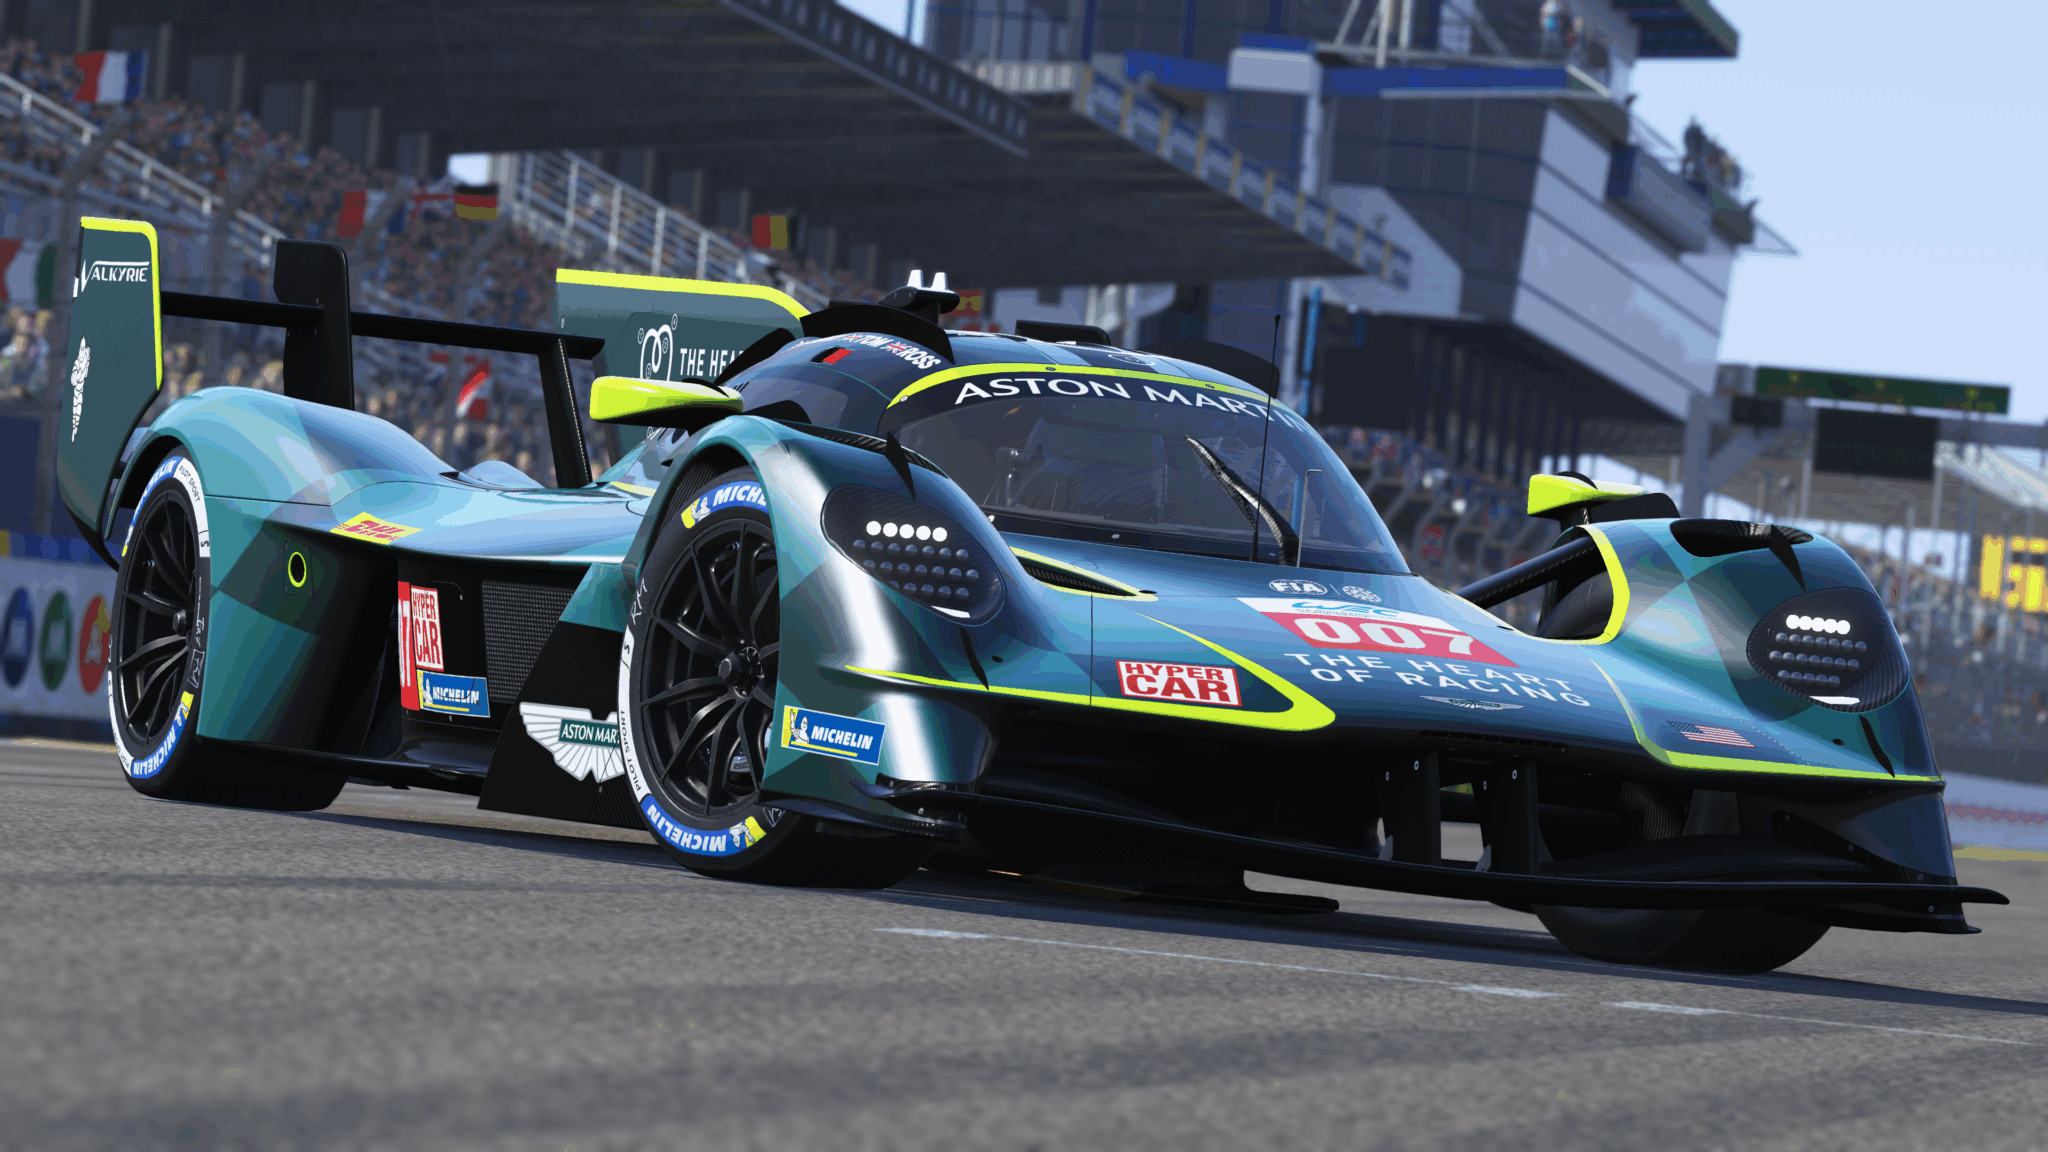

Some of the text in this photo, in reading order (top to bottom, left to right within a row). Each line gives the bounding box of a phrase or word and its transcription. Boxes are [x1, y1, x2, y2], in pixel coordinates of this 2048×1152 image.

[80, 260, 150, 293] VALKYRIE
[680, 348, 744, 377] THE HEA
[895, 347, 941, 369] ROSS
[955, 378, 1132, 405] ASTON
[178, 465, 201, 502] PILOT SPORT
[1271, 582, 1324, 593] FIA
[412, 590, 437, 620] HYPER
[414, 618, 441, 665] CAR
[1294, 617, 1475, 656] 007
[1124, 662, 1225, 682] HYPER
[1283, 653, 1573, 692] THE HEART
[433, 685, 480, 705] MICHELIN
[1126, 674, 1232, 703] CAR
[1310, 668, 1591, 707] OF RACING
[561, 723, 594, 741] ASTON
[811, 725, 873, 750] MICHELIN
[133, 725, 177, 775] MICHELIN
[620, 710, 642, 791] PILOT SPORT
[647, 804, 727, 852] MICHELIN
